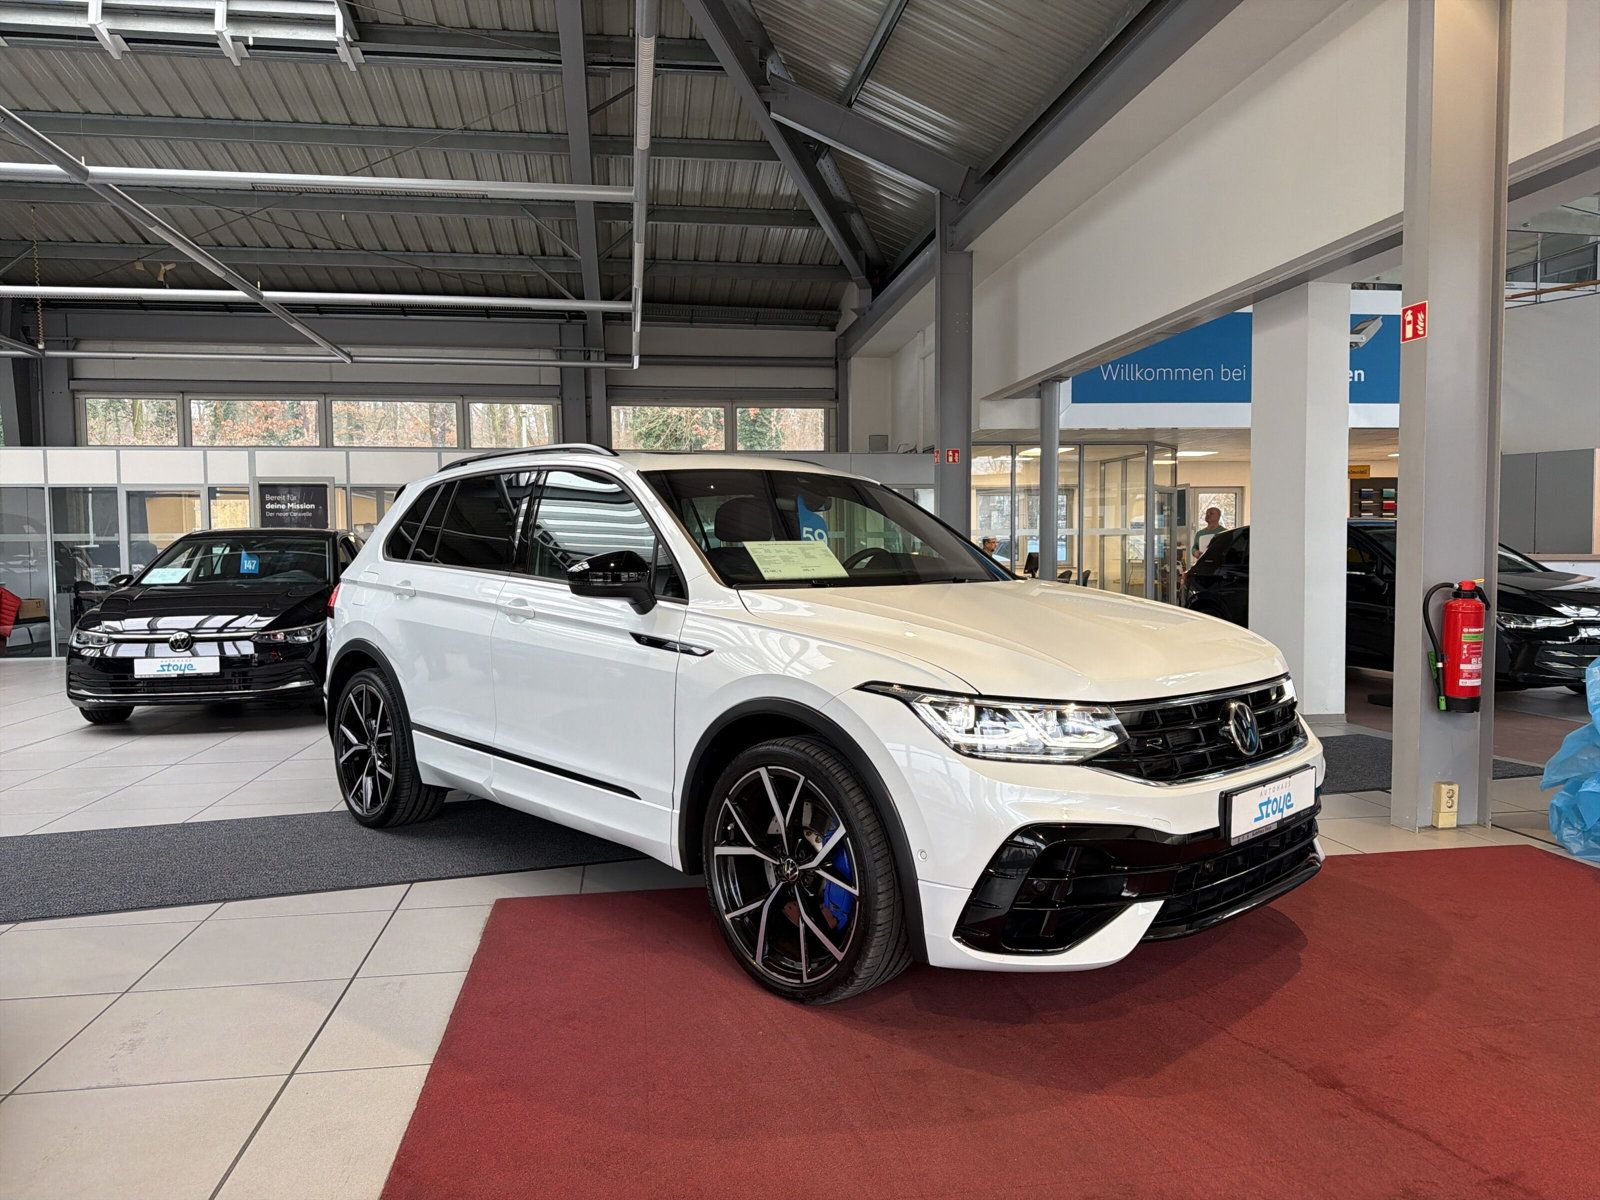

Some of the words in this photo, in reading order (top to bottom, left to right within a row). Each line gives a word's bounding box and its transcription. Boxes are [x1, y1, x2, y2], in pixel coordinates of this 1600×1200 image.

[1100, 363, 1214, 381] Willkommen
[1220, 363, 1247, 381] bei
[265, 493, 286, 501] Bereit
[286, 493, 297, 501] für
[802, 527, 828, 543] 59
[244, 560, 257, 570] 147
